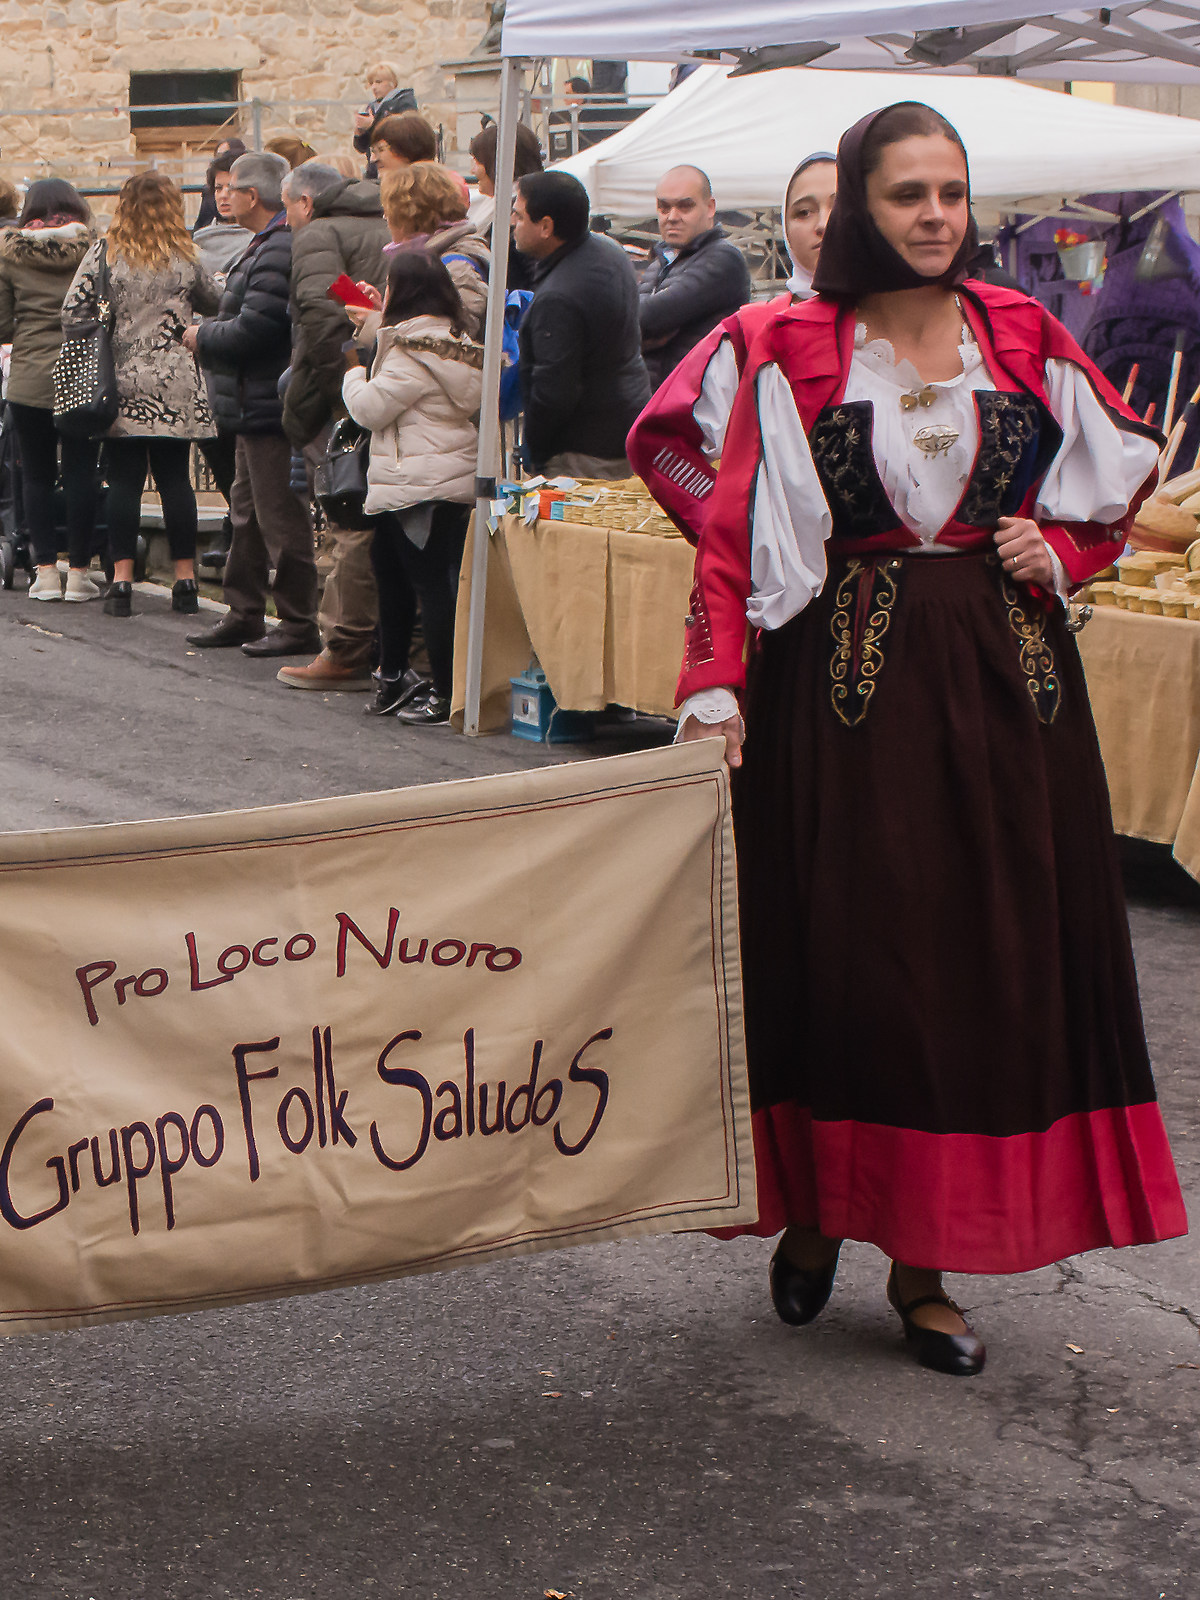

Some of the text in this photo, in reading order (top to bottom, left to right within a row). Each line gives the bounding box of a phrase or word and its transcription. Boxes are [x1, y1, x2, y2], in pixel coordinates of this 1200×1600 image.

[76, 907, 522, 1025] Pro Loco Nuoro
[232, 1025, 358, 1182] Folk
